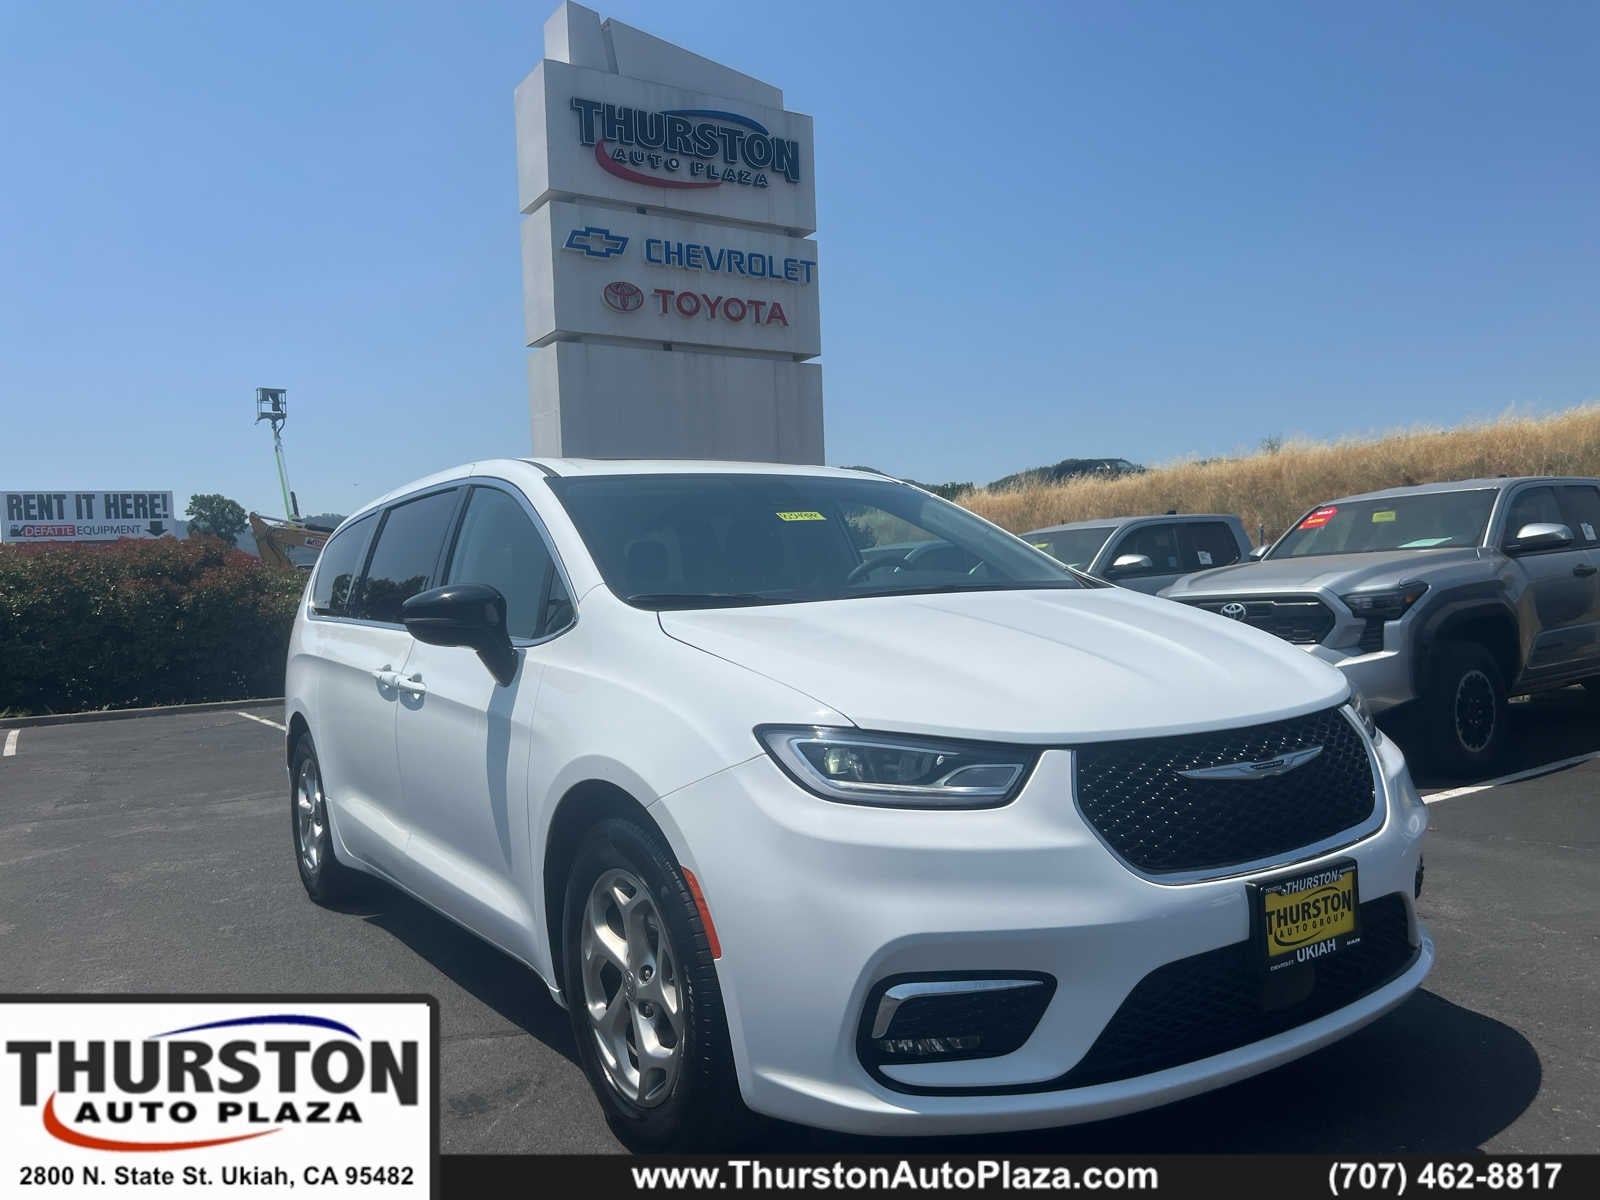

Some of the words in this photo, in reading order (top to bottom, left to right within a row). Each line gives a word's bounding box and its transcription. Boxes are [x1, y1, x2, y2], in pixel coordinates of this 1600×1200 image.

[570, 97, 800, 184] THURSTON
[612, 147, 681, 173] AUTO
[691, 160, 768, 188] PLAZA
[645, 238, 817, 284] CHEVROLET
[654, 288, 789, 327] TOYOTA
[6, 494, 67, 521] RENT
[75, 493, 96, 520] IT
[103, 493, 169, 519] HERE!
[24, 525, 74, 537] DEFATTE
[76, 524, 142, 536] EQUIPMENT
[1285, 869, 1338, 895] THURSTON
[1266, 889, 1352, 936] THURSTON
[1296, 938, 1336, 962] UKIAH
